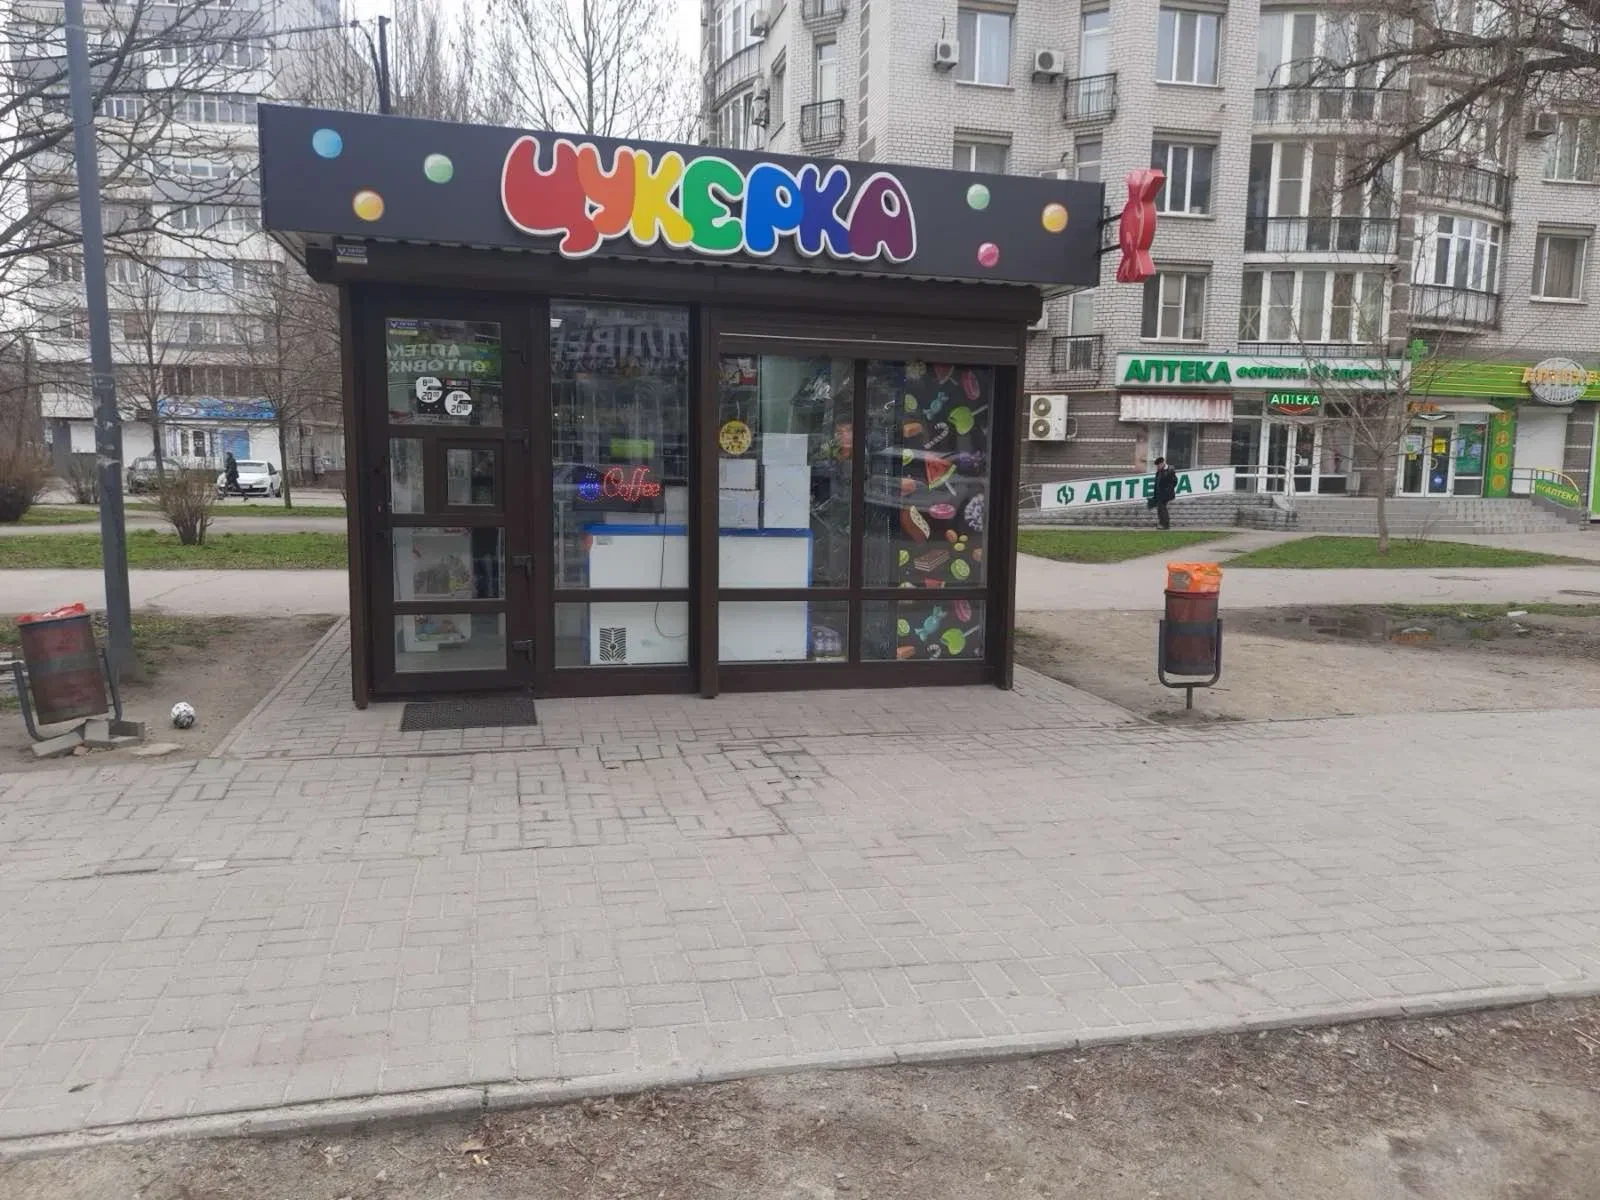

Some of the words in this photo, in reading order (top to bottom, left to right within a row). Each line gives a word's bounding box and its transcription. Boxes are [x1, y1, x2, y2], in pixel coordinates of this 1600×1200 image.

[501, 135, 917, 262] ЦУКЕРКА
[1123, 359, 1232, 384] АПТЕКА
[1270, 393, 1321, 406] АПТЕКА
[603, 464, 661, 502] Coffee
[1084, 474, 1193, 503] АПТЕА
